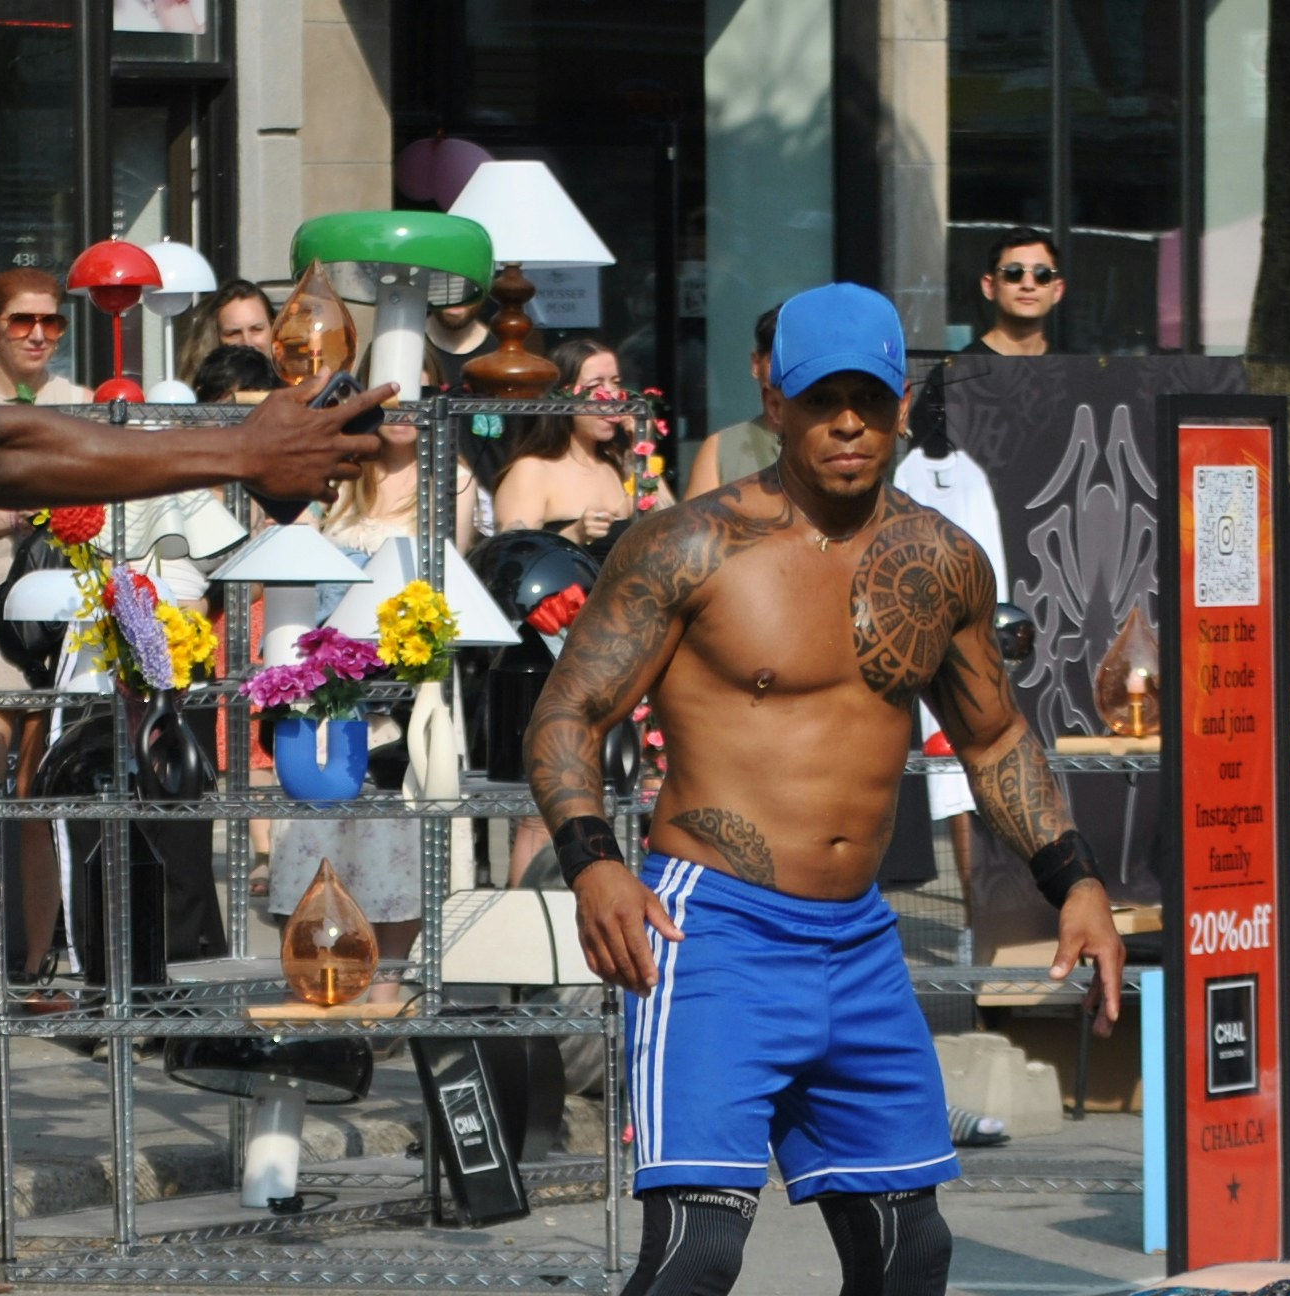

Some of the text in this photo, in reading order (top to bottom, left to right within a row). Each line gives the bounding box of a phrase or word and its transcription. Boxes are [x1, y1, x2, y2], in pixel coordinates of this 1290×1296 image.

[1198, 617, 1255, 643] Scan the
[1200, 662, 1255, 695] QR code
[1202, 708, 1255, 742] and join
[1219, 760, 1243, 780] our
[1195, 803, 1264, 834] Instagram
[1209, 845, 1251, 878] family
[1189, 903, 1273, 957] 20%off
[1214, 1022, 1246, 1044] CHAL
[454, 1114, 482, 1135] CHAL
[1201, 1119, 1265, 1152] CHAL.CA
